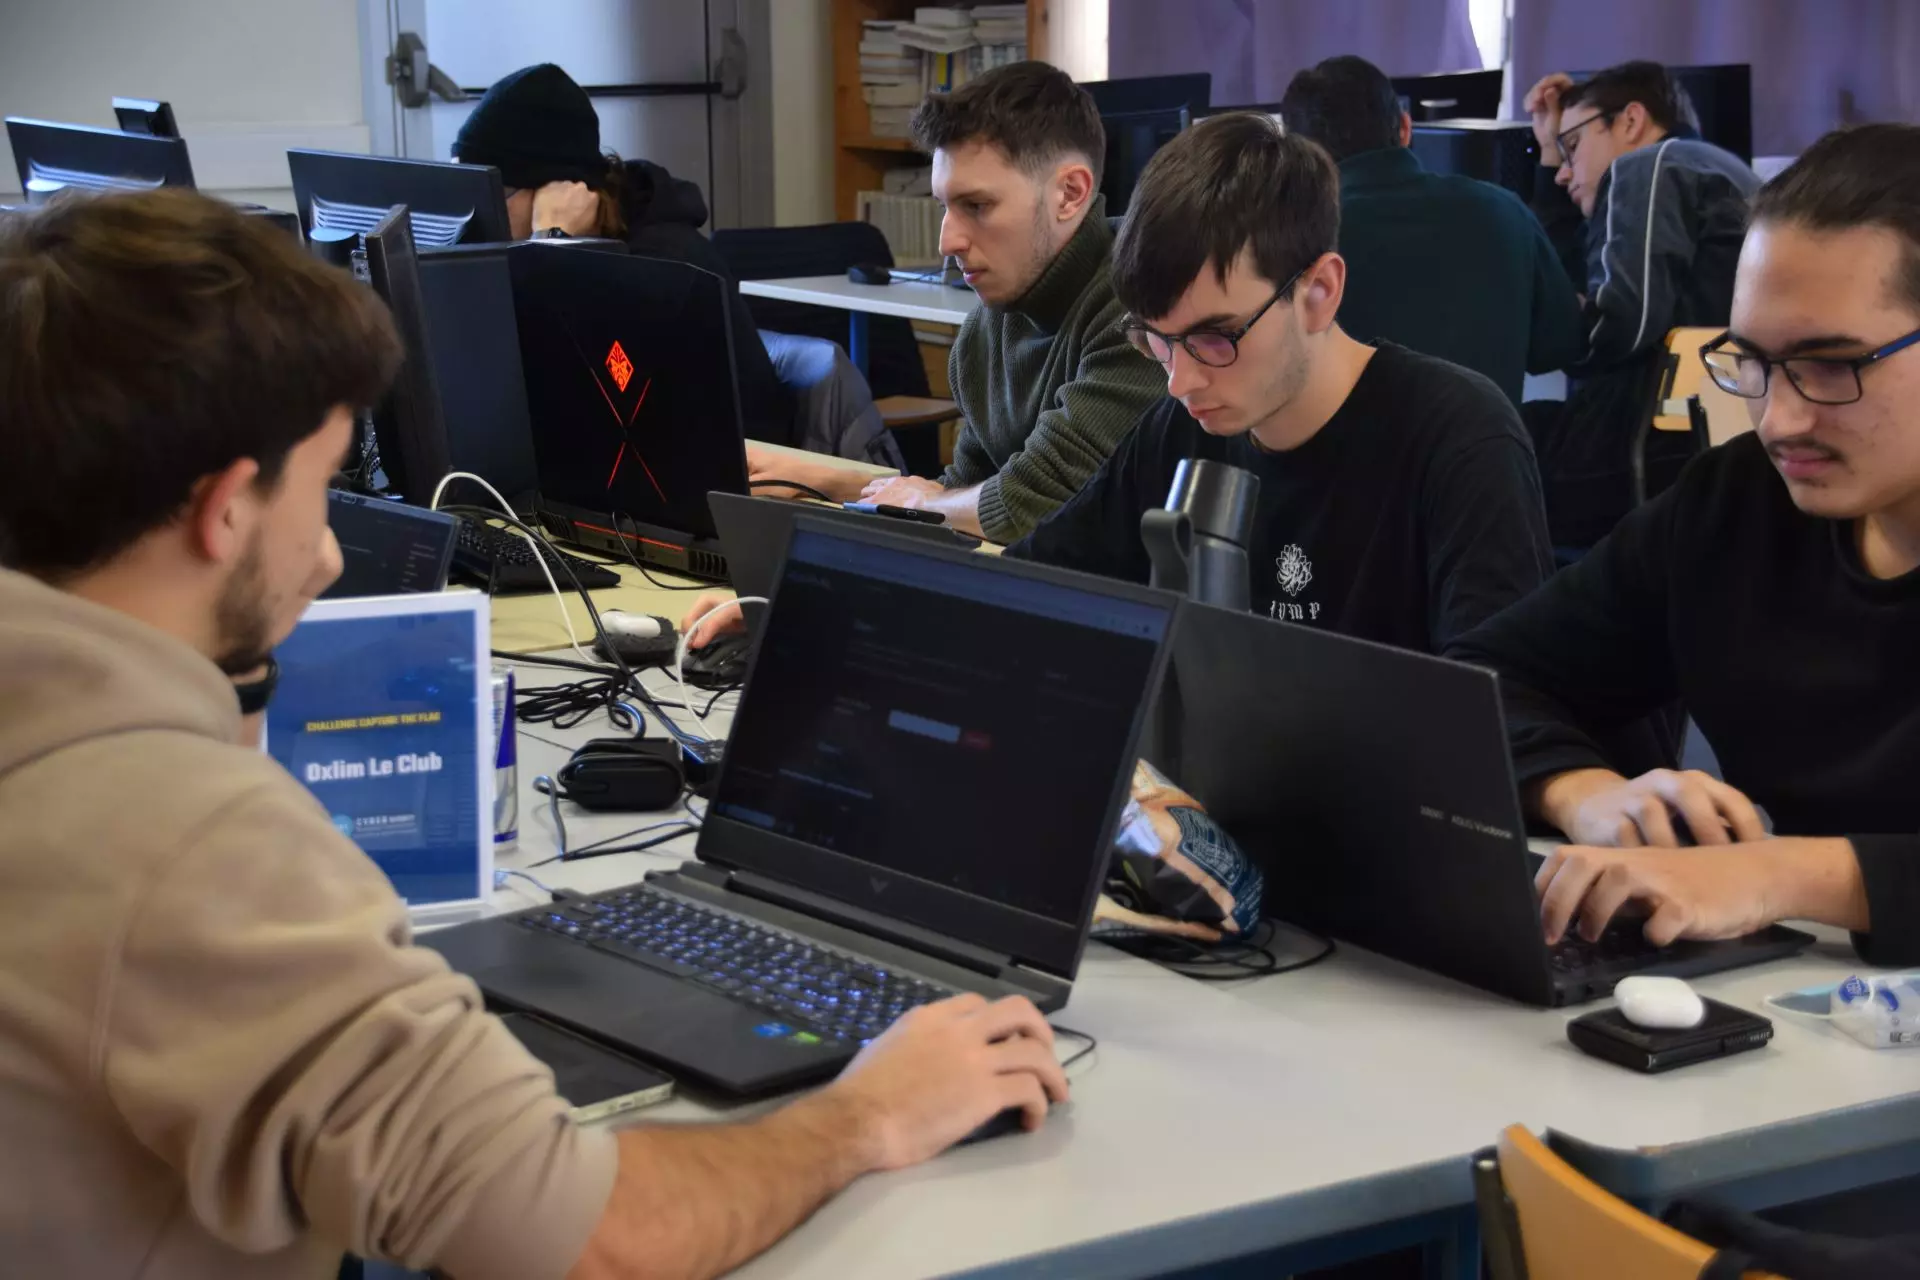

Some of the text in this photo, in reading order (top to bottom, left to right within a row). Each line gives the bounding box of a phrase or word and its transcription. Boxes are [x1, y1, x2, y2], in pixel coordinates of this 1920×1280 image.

[307, 711, 441, 732] CHALLENGE CAPTURE THE FLAG
[369, 757, 393, 776] Le
[397, 751, 442, 774] Club
